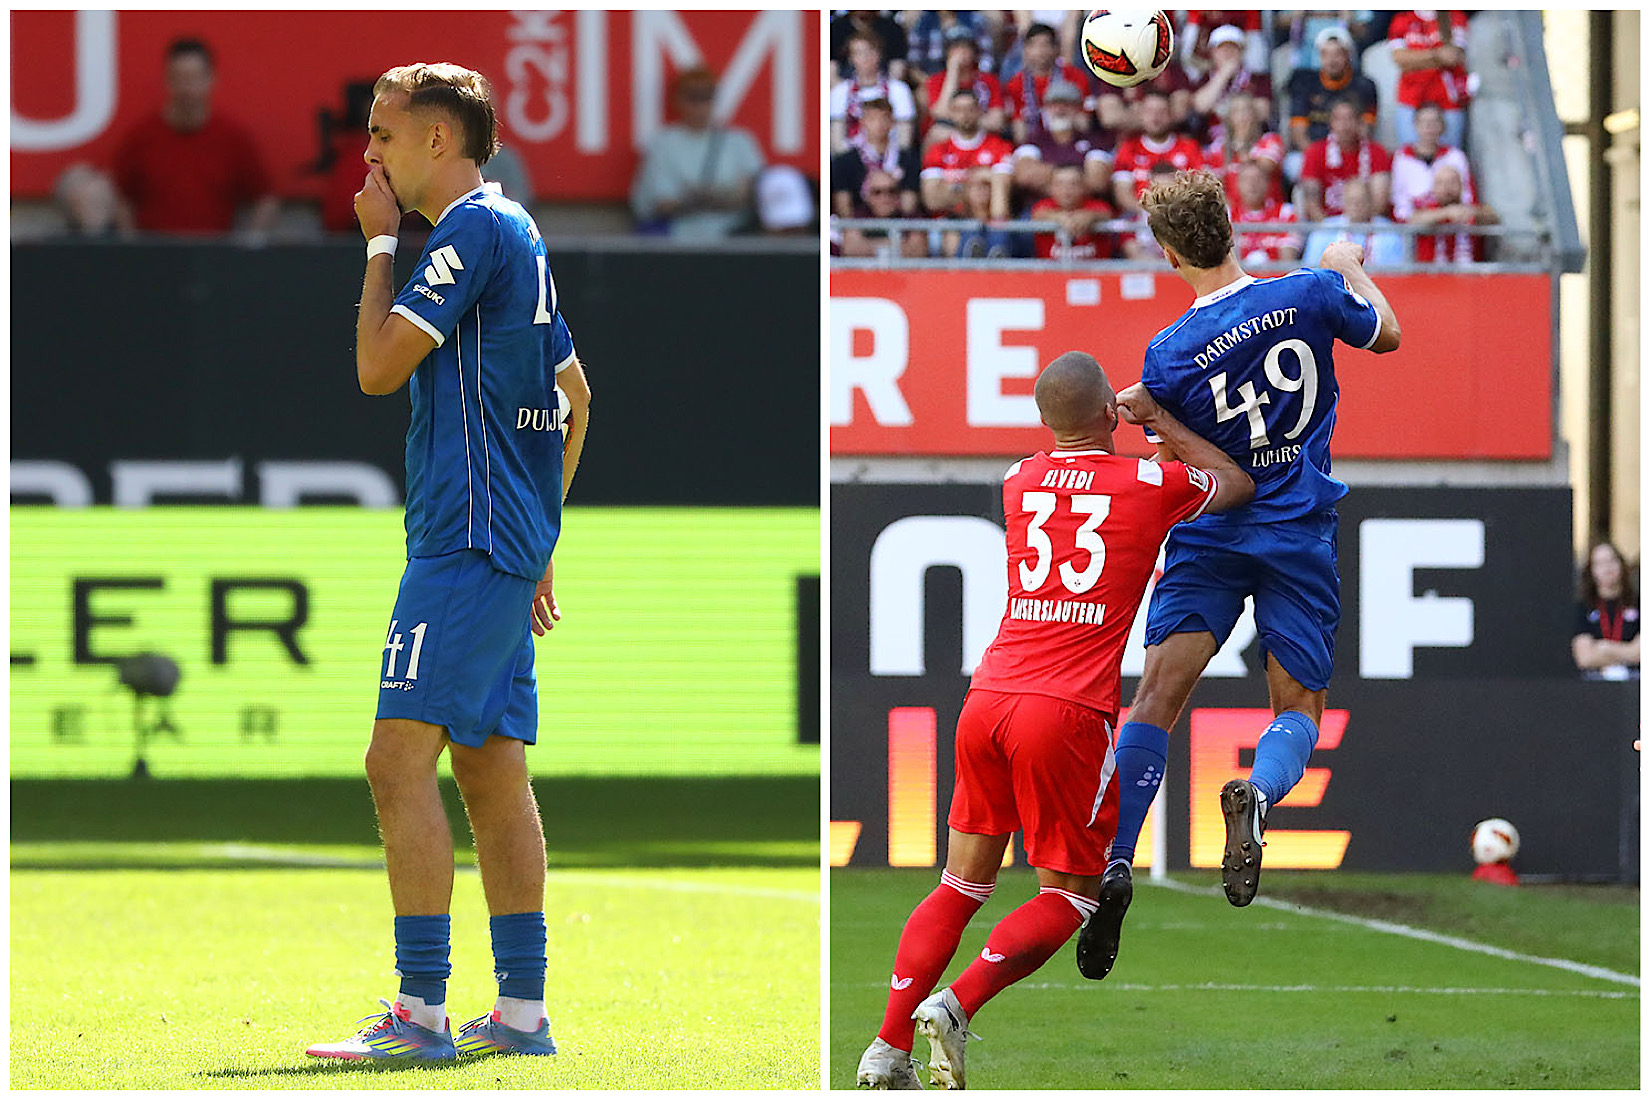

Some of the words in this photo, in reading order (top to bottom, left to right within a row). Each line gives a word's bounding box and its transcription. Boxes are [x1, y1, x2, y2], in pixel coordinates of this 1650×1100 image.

[830, 296, 1046, 428] RE
[1193, 307, 1298, 370] DARMSTADT
[1208, 338, 1319, 449] 49
[1018, 491, 1112, 594] 33
[10, 575, 312, 666] ER
[384, 619, 428, 680] 41
[380, 680, 406, 690] CRAFT
